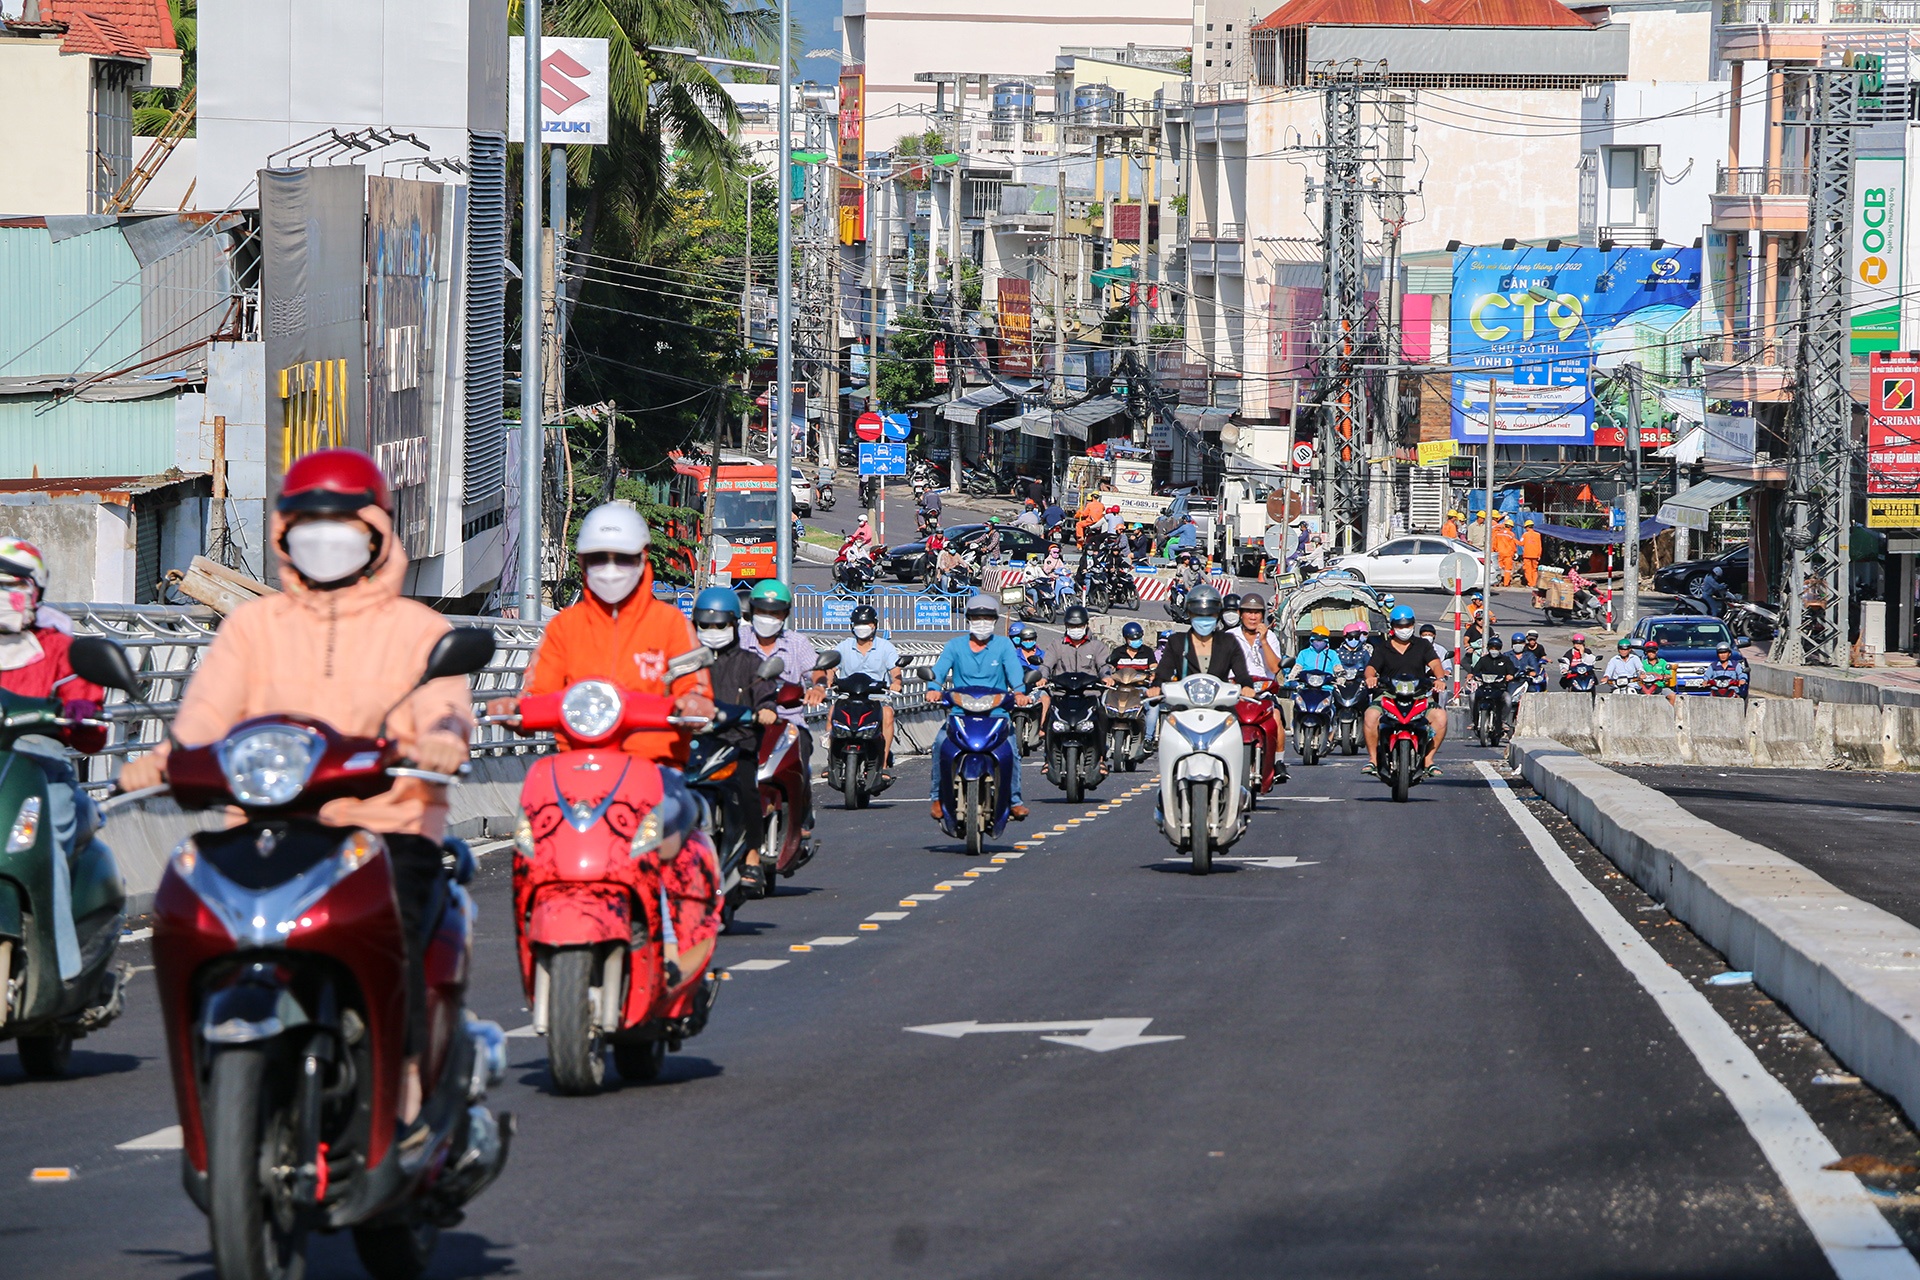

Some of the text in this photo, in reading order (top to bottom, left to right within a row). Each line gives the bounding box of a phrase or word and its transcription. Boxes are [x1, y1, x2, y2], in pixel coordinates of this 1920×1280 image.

[541, 121, 591, 133] UZUKI
[1862, 187, 1886, 253] OCB
[1533, 262, 1553, 273] tháng
[1502, 276, 1528, 289] CĂN
[1469, 292, 1583, 342] CT9
[1491, 344, 1515, 354] KHU
[1540, 344, 1559, 355] THỊ
[1474, 355, 1502, 367] VĨNH
[1297, 448, 1310, 462] 40
[744, 536, 761, 545] BUÝT
